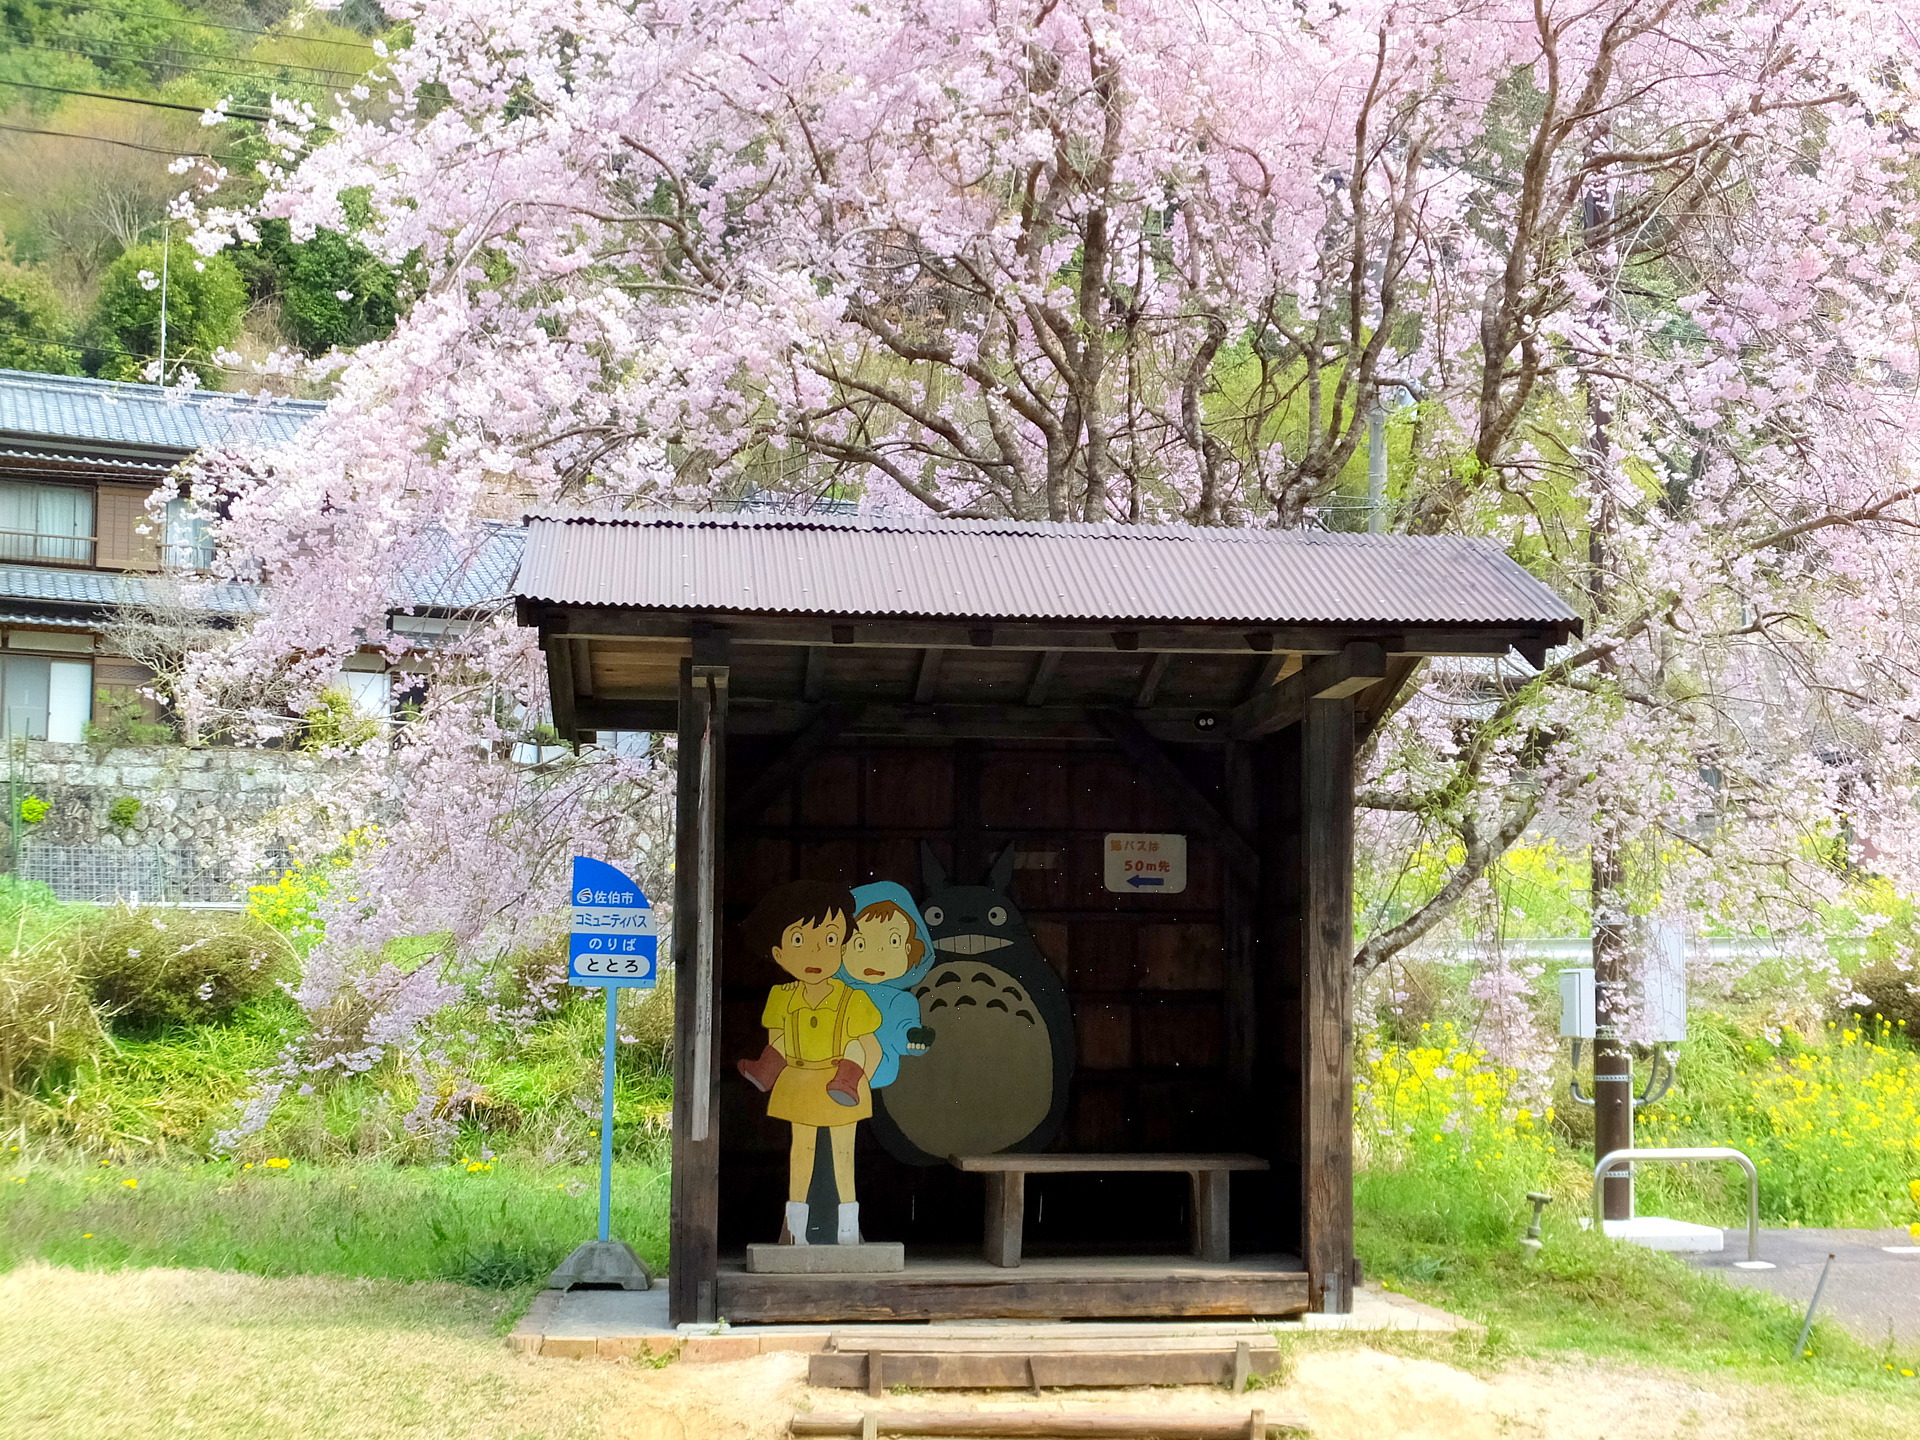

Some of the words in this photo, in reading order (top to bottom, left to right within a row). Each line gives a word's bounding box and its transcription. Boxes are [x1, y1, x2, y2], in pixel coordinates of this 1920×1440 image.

[1124, 860, 1171, 873] 50m先
[594, 890, 634, 904] 佐伯市
[576, 913, 648, 928] コミュニティバス
[589, 938, 637, 951] のりば
[587, 958, 638, 973] ととろ
